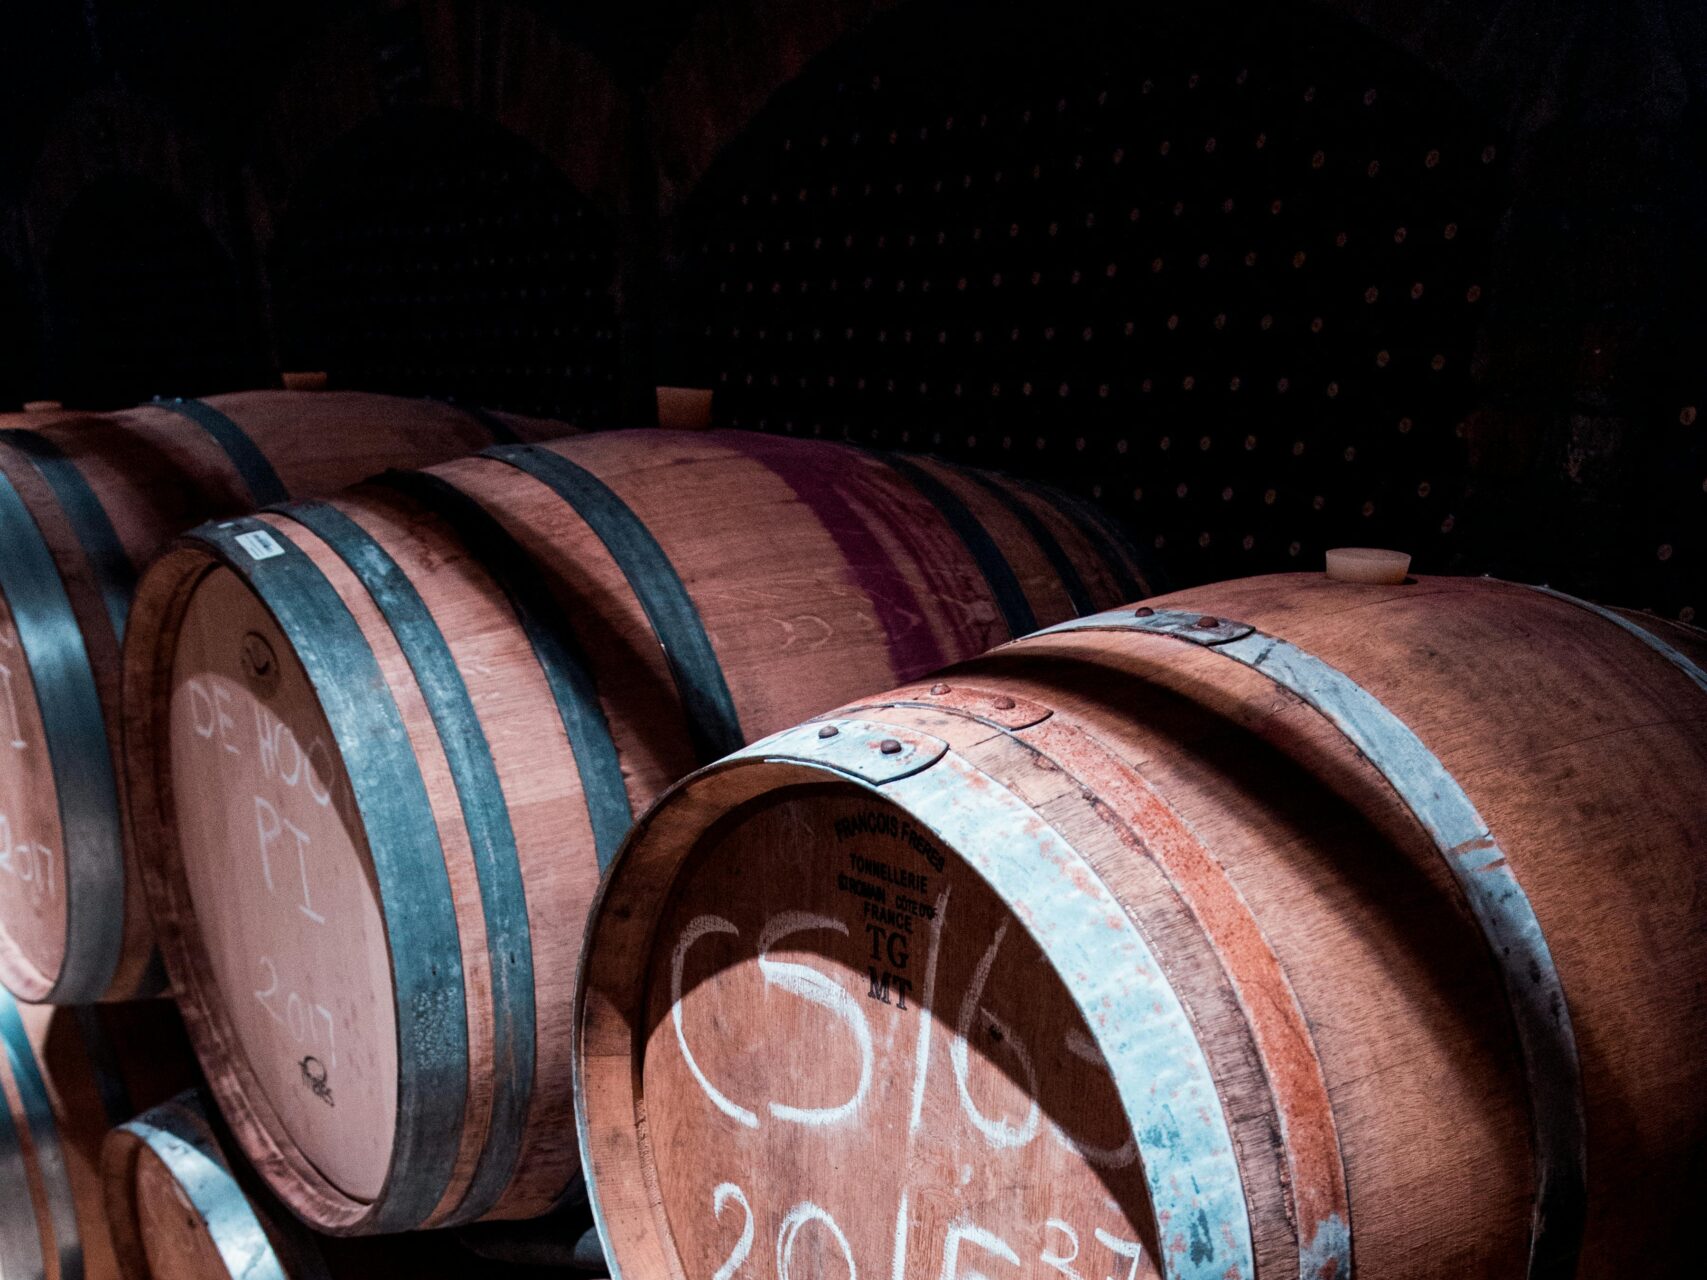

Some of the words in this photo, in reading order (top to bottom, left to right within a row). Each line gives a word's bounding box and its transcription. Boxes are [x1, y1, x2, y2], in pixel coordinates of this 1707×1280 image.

[849, 852, 928, 894] TONNELLERIE
[863, 902, 914, 934] FRANCE
[866, 924, 910, 968] TG
[867, 965, 913, 1011] MT
[254, 956, 336, 1069] 2017
